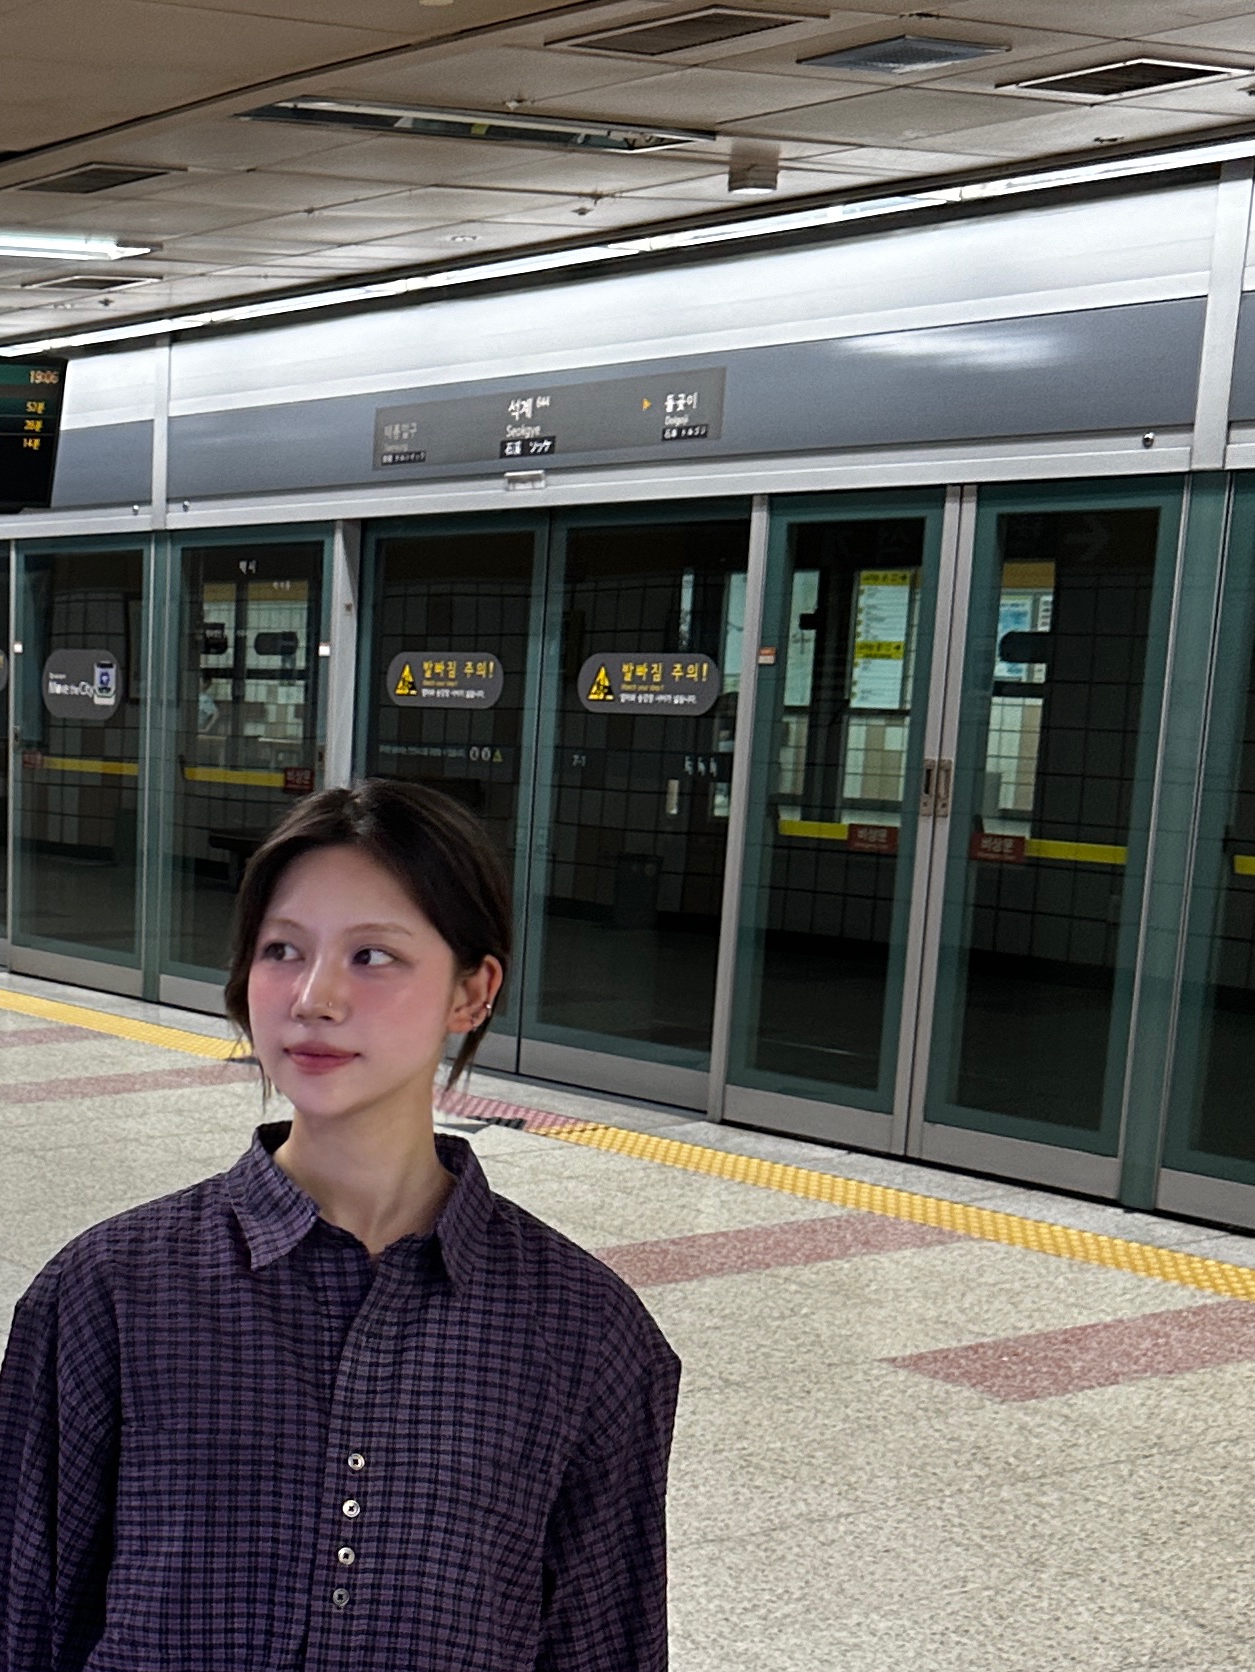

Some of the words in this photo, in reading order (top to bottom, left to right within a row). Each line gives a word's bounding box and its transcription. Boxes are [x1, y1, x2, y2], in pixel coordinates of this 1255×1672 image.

[29, 370, 59, 384] 19:06
[508, 397, 533, 421] 석계
[422, 660, 457, 679] 발빠짐
[464, 660, 494, 679] 주의!
[622, 662, 662, 682] 발빠짐
[671, 662, 709, 682] 주의!
[858, 828, 888, 843] 비상문
[981, 836, 1015, 854] 비상문
